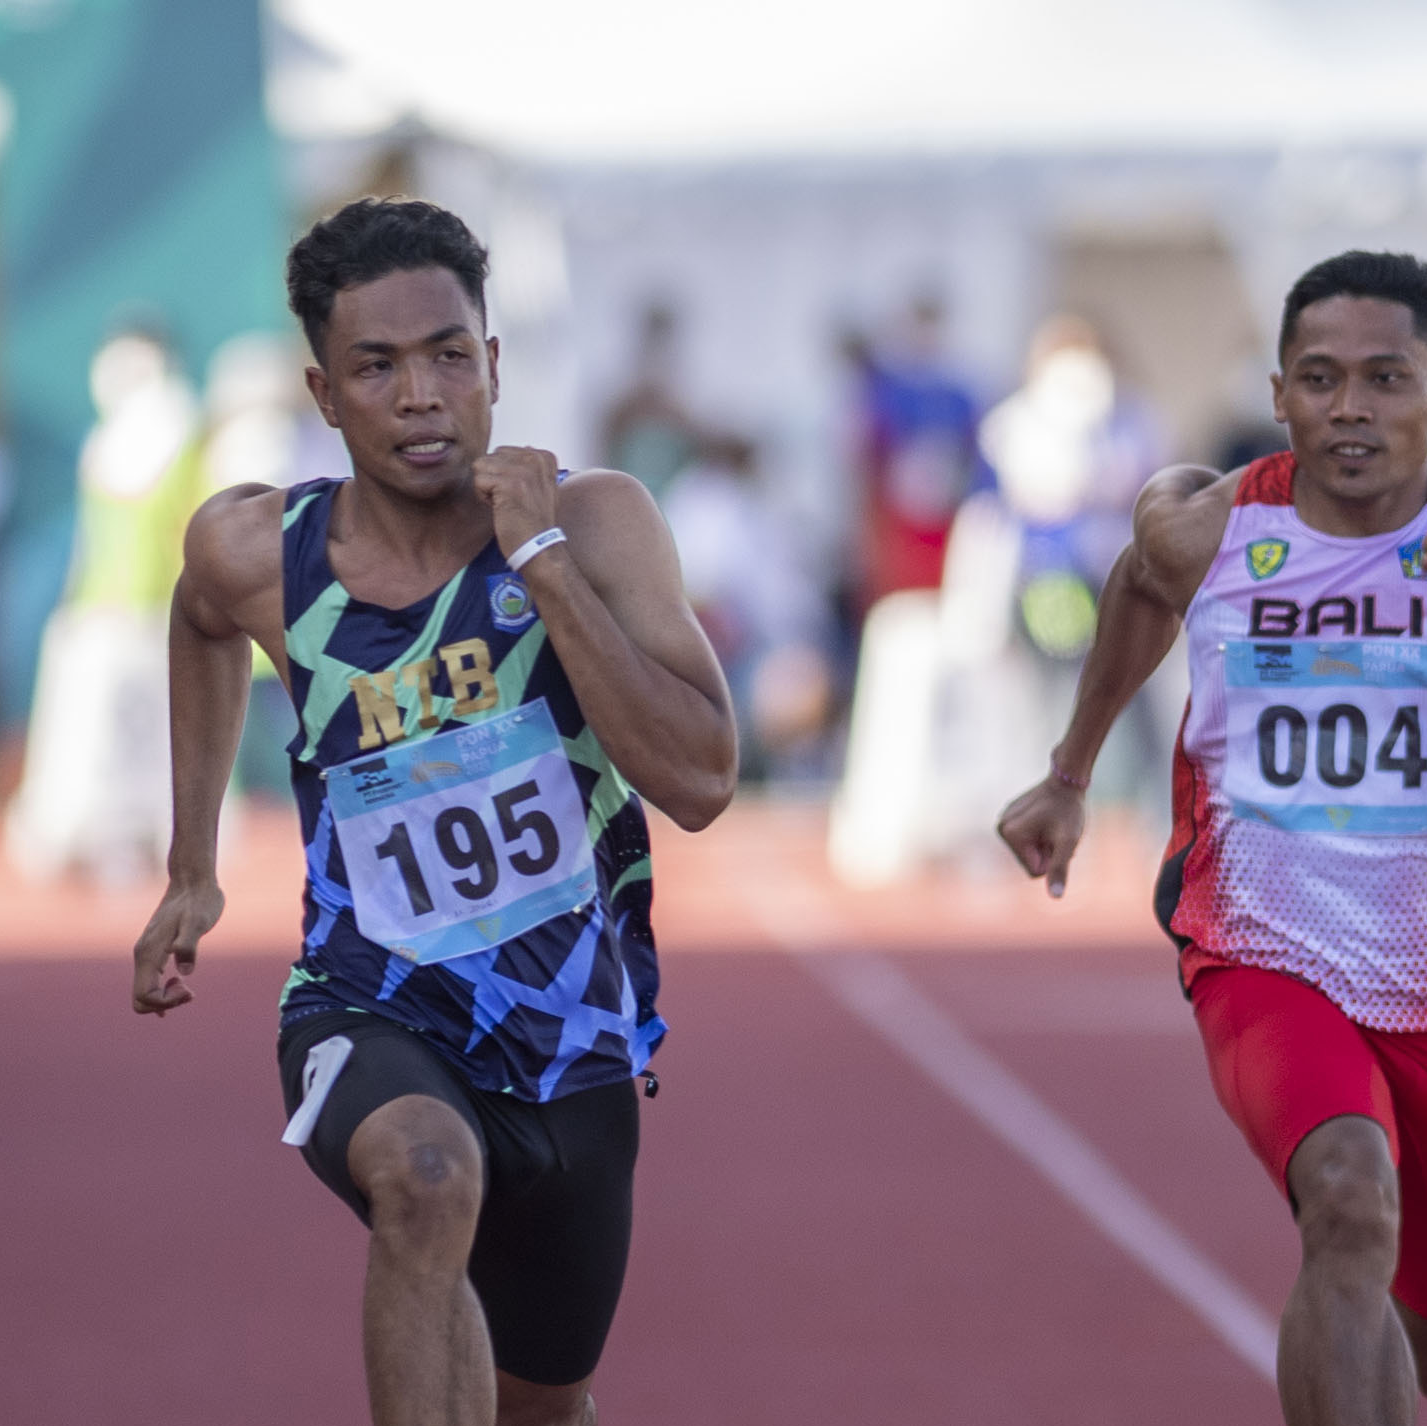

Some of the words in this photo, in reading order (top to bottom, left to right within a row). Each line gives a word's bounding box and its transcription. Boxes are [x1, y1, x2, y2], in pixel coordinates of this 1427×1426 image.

[1248, 596, 1424, 638] BALI
[349, 637, 498, 750] NTB
[375, 779, 560, 918] 195
